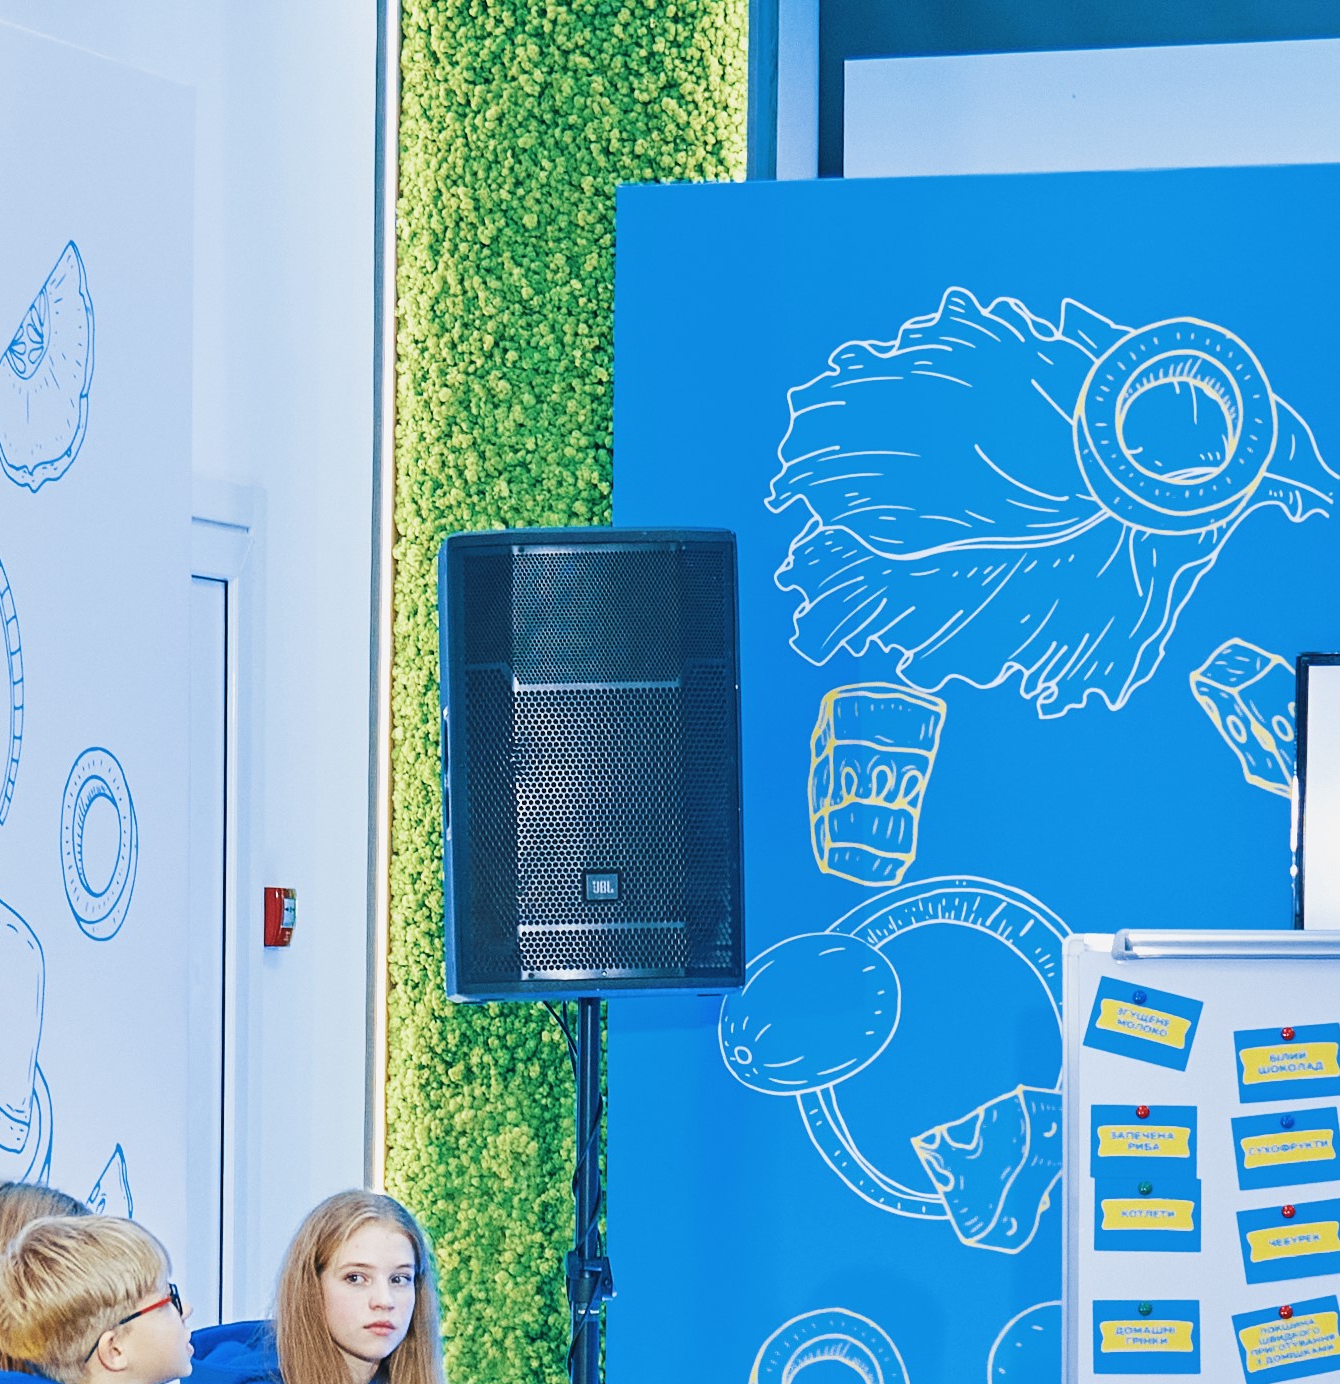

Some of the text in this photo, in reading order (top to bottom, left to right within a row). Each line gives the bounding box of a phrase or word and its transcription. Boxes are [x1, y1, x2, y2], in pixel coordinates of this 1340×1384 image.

[592, 880, 614, 893] JBL
[1117, 1007, 1171, 1026] ЗГУЩЕНЕ
[1117, 1018, 1168, 1037] МОЛОКО
[1257, 1061, 1325, 1075] ШОКОЛАД
[1110, 1131, 1174, 1140] ЗАПЕЧЕНА
[1127, 1142, 1161, 1151] РИБА
[1247, 1140, 1329, 1156] СУХОФРУКТИ
[1120, 1209, 1175, 1218] КОТЛЕТИ
[1268, 1234, 1321, 1247] ЧЕБУРЕК
[1114, 1326, 1176, 1335] ДОМАШНІ
[1258, 1327, 1321, 1345] ШВИДКОГО
[1125, 1337, 1168, 1345] ГРІНКИ
